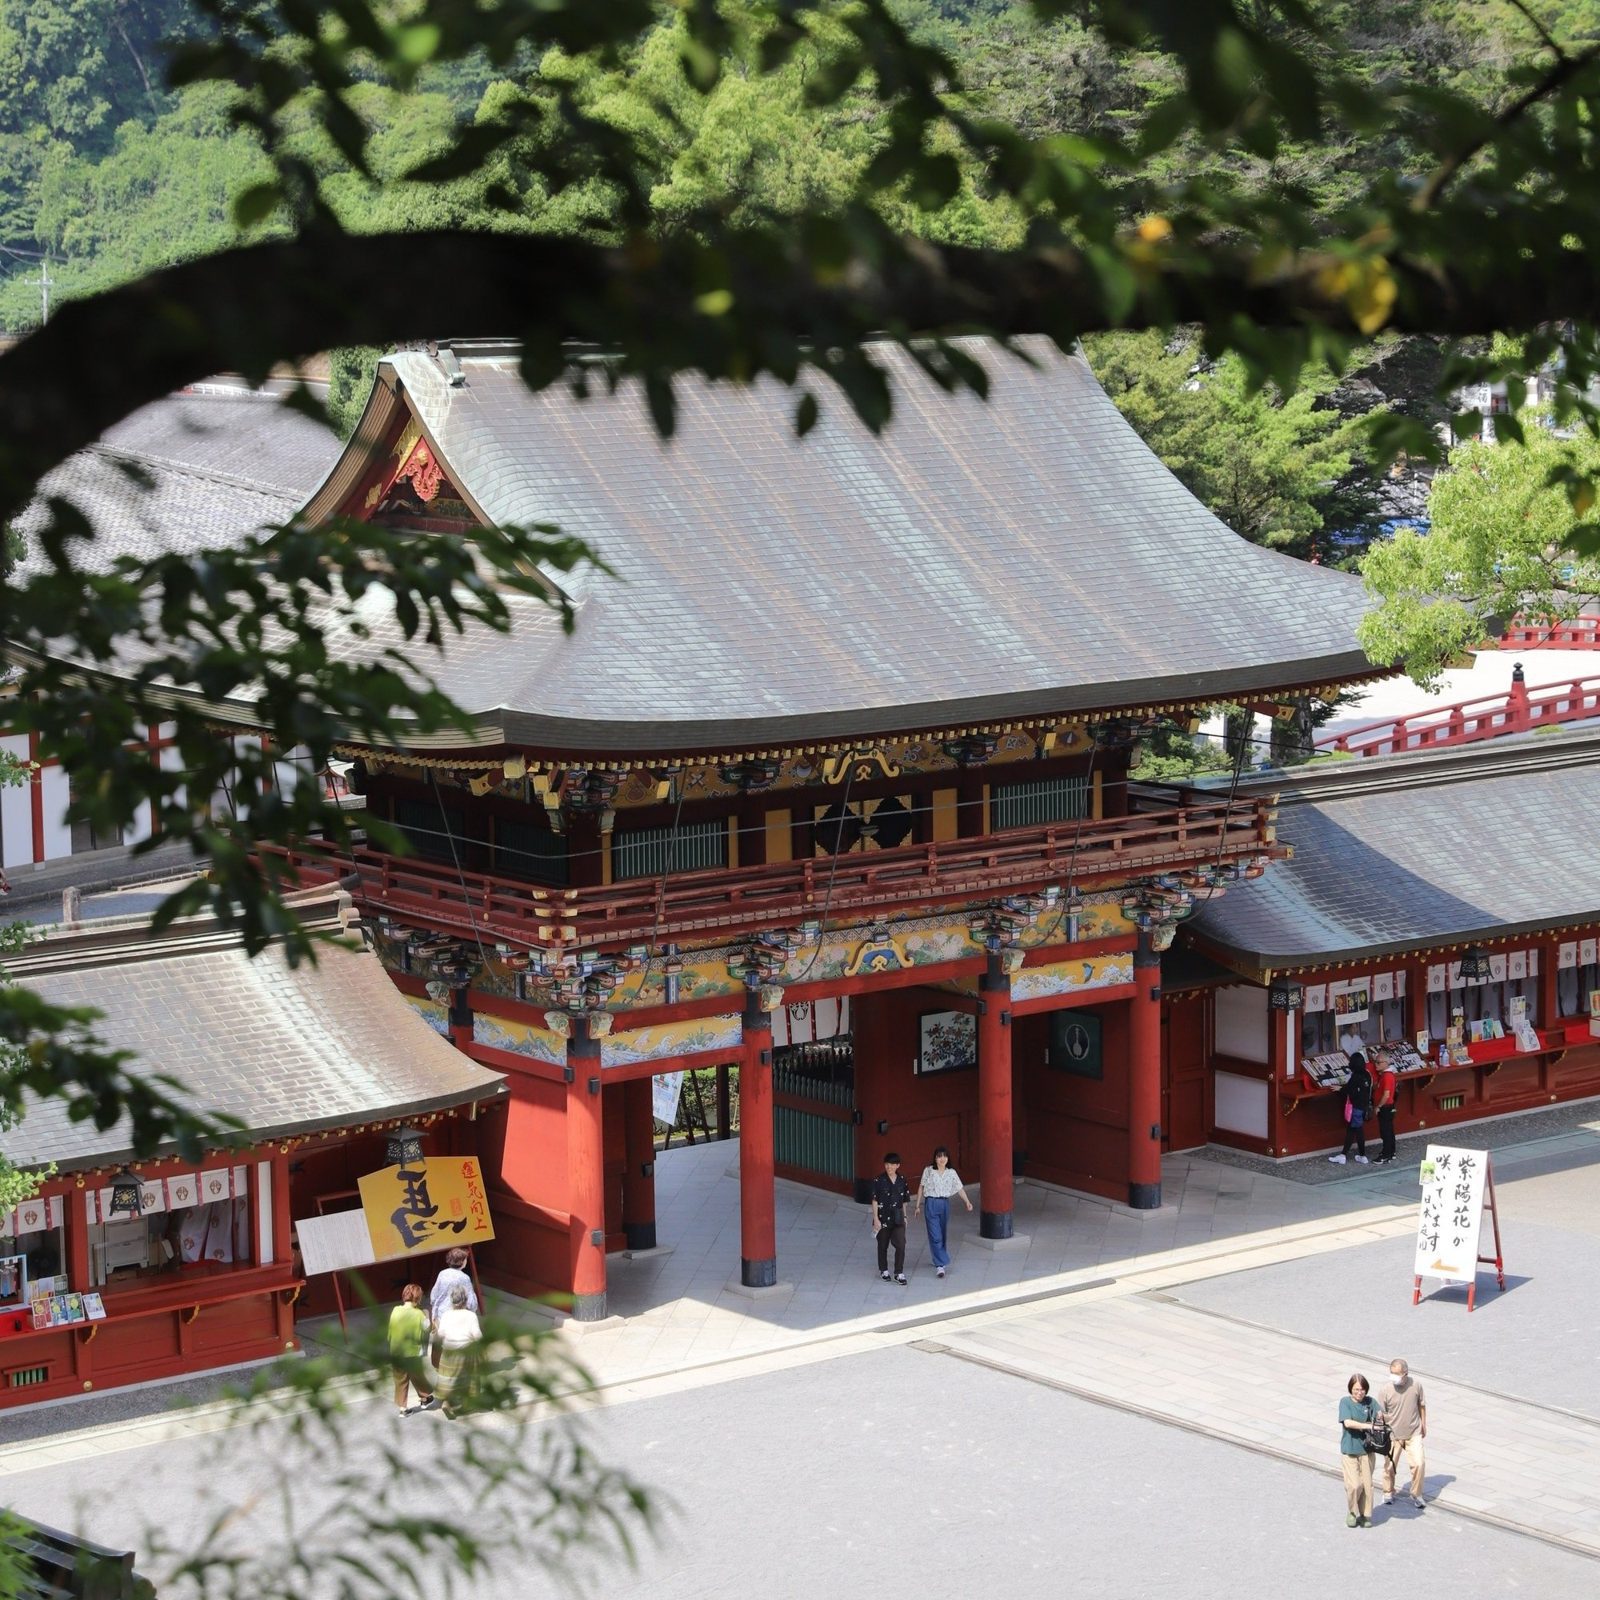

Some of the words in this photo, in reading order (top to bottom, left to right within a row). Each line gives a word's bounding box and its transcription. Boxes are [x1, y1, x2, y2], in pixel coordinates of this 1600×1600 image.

[461, 1161, 487, 1230] 運気向上
[1427, 1154, 1451, 1252] 咲いています
